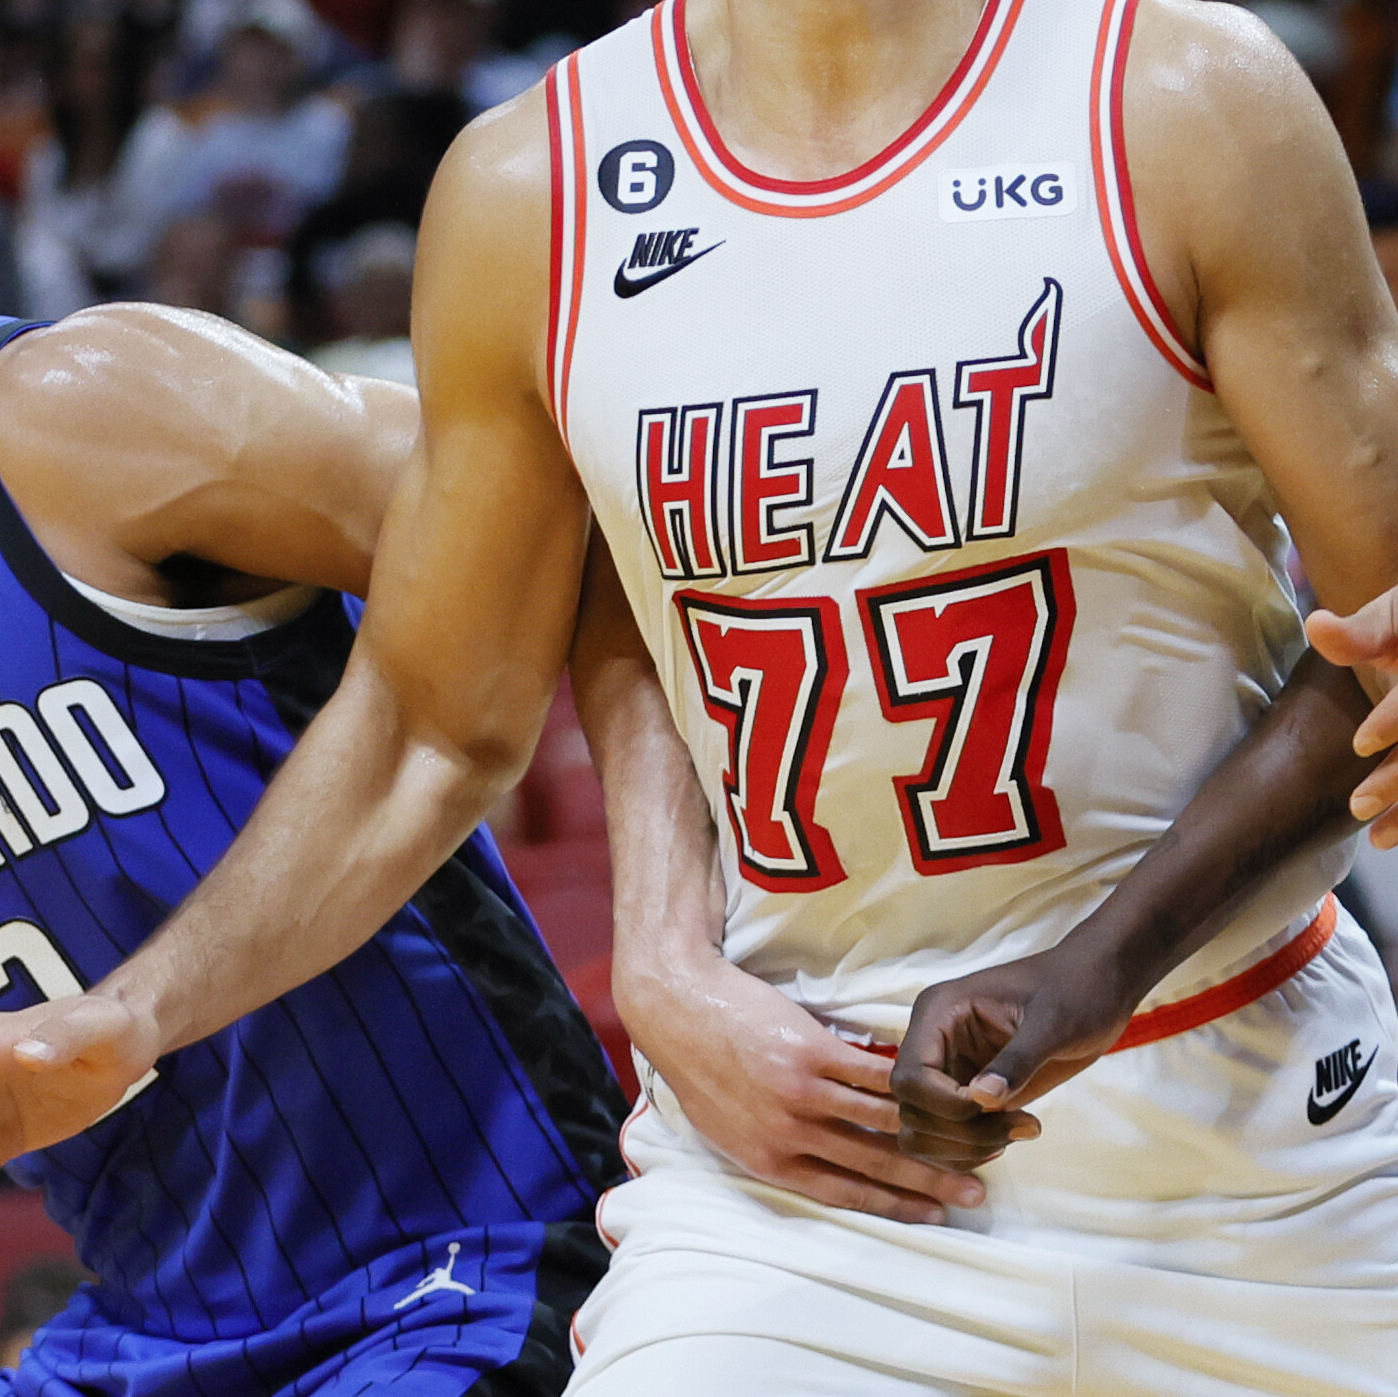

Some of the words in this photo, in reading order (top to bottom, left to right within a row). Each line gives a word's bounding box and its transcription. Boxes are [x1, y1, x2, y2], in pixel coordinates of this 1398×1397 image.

[617, 151, 658, 204] 6
[628, 228, 700, 269] NIKE
[636, 276, 1064, 579] HEAT
[673, 547, 1078, 894] 77
[1315, 1038, 1363, 1098] NIKE
